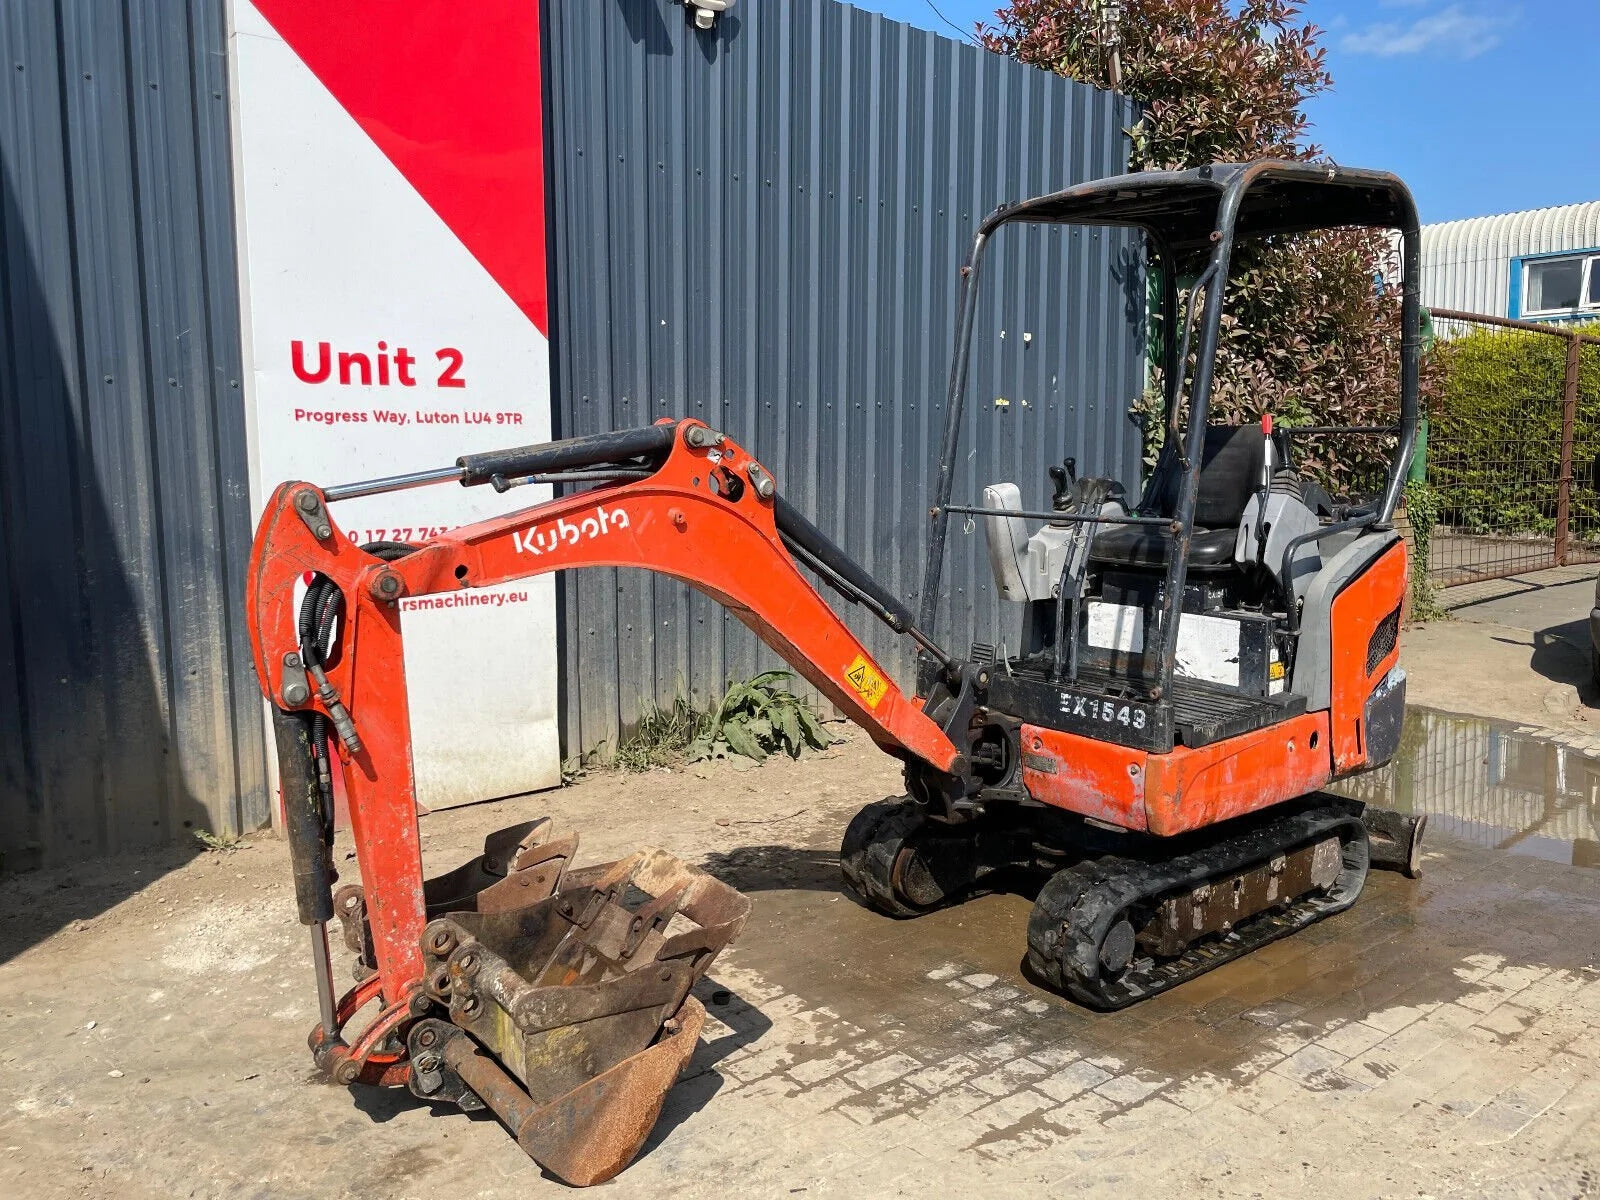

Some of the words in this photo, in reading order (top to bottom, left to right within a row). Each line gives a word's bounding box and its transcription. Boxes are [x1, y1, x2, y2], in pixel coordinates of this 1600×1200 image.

[291, 340, 417, 386] Unit
[435, 347, 466, 388] 2
[295, 409, 368, 425] Progress
[373, 410, 411, 426] Way,
[416, 411, 460, 424] Luton
[464, 411, 492, 424] LU4
[496, 412, 523, 425] 9TR
[392, 528, 413, 542] 27
[513, 506, 630, 555] Kubota
[399, 591, 528, 611] rsmachinery.eu
